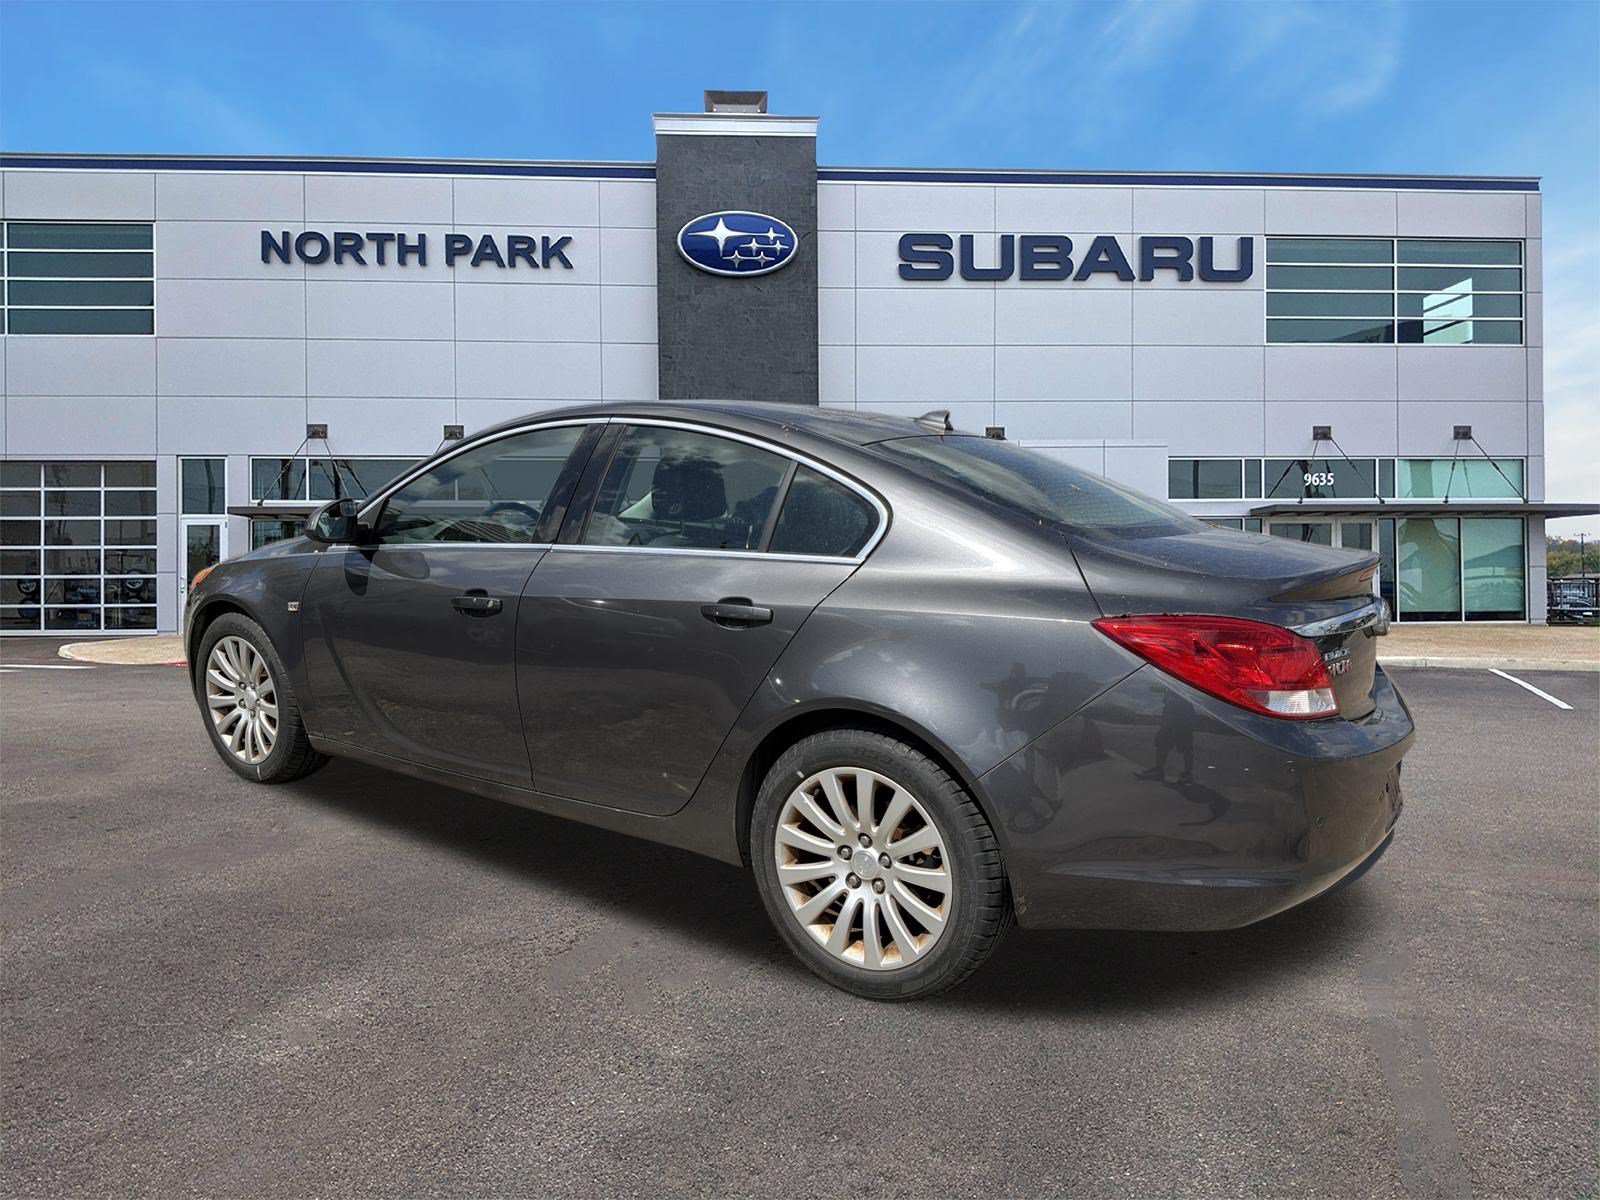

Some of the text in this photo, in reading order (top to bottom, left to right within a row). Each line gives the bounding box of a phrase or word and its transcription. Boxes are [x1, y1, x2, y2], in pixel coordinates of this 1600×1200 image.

[261, 230, 574, 269] NORTH PARK
[898, 233, 1254, 283] SUBARU
[1303, 472, 1335, 486] 9635
